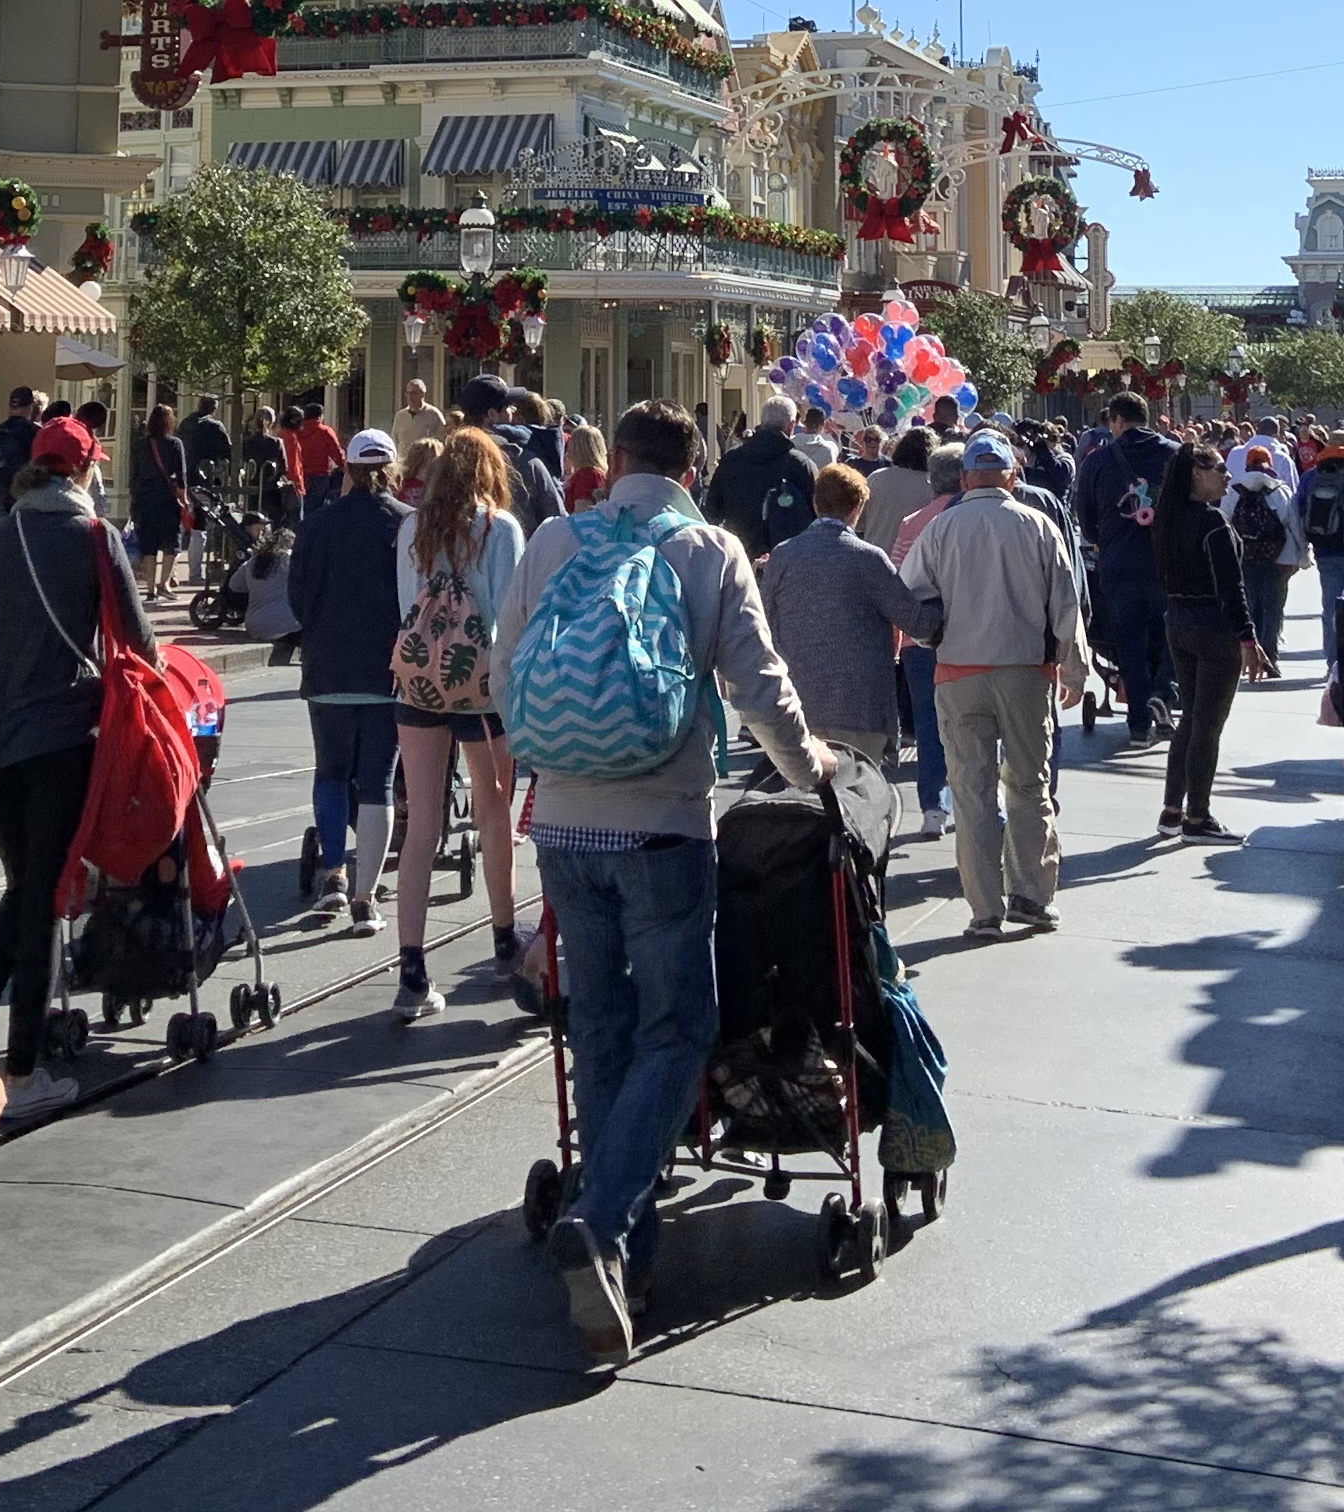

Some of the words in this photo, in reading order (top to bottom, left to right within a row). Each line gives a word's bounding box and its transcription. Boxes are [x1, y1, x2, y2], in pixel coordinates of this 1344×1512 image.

[545, 189, 595, 199] JEWELRY
[606, 190, 640, 200] CHINA
[650, 191, 699, 203] TIMEPIECES
